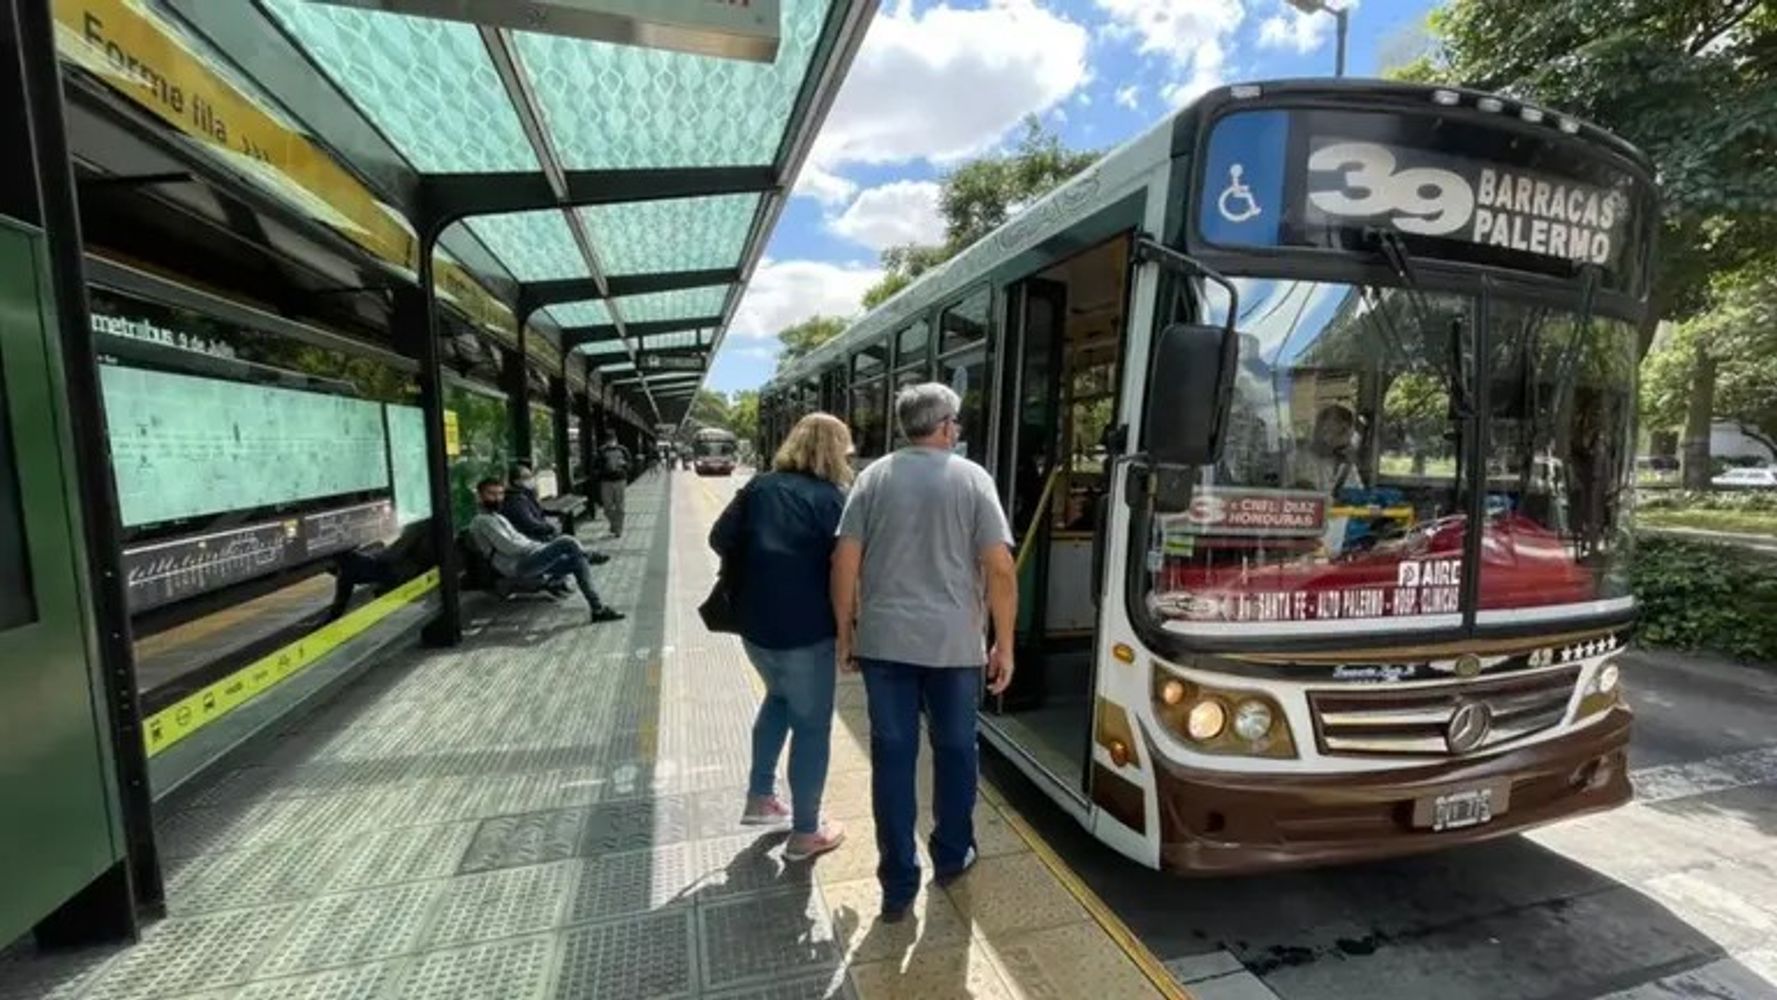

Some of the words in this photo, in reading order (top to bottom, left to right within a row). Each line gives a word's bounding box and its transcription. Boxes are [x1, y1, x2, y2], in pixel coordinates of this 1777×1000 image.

[84, 11, 184, 113] Forme
[192, 92, 228, 144] fila
[1308, 141, 1474, 236] 39
[1479, 169, 1617, 230] BARRACAS
[1473, 209, 1611, 264] PALERMO
[1228, 512, 1314, 526] HONDURAS
[1422, 560, 1462, 585] AIRE
[1294, 591, 1307, 618] FE
